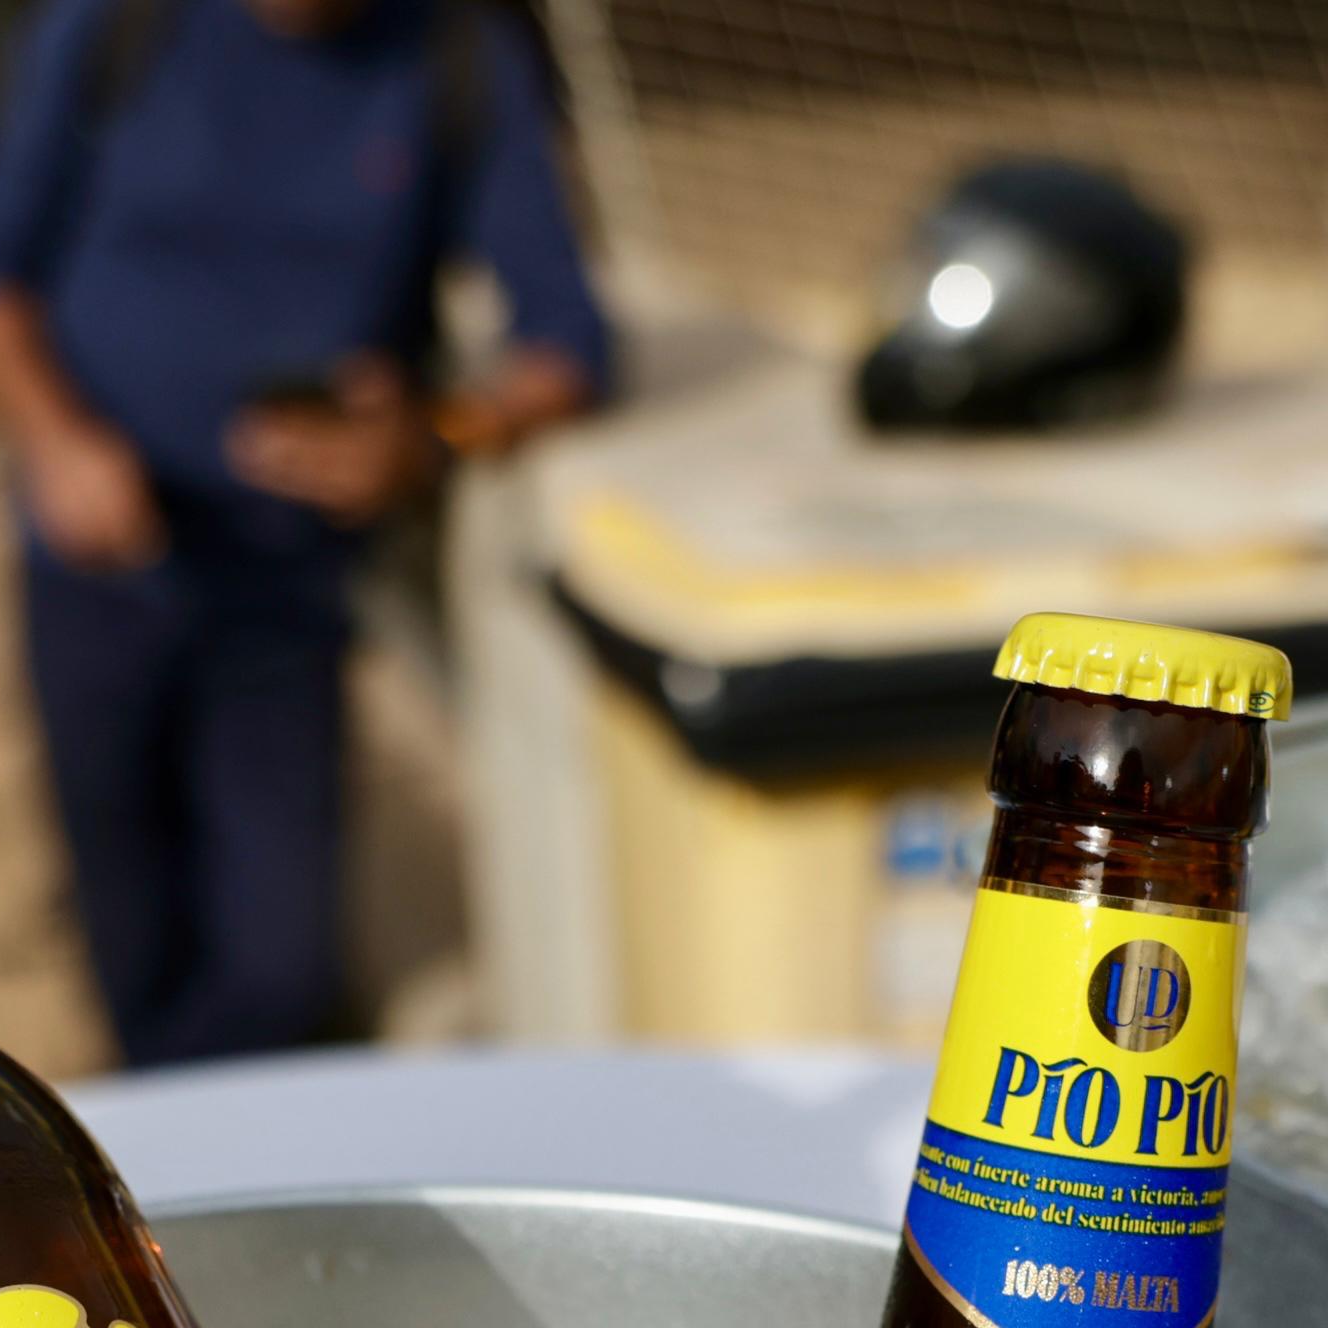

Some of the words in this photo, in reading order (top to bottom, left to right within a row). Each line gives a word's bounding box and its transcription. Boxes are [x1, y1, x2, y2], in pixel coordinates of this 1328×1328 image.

[1105, 961, 1178, 1030] UD
[982, 1046, 1121, 1149] PÍO
[1135, 1070, 1230, 1156] PÍO
[939, 1176, 1037, 1219] balanceado
[1042, 1203, 1072, 1225] del
[1078, 1208, 1185, 1235] sentimiento
[945, 1155, 971, 1173] con
[973, 1156, 1030, 1188] fuerte
[1034, 1173, 1105, 1200] aroma
[1111, 1185, 1123, 1202] a
[1130, 1184, 1198, 1207] victoria,
[1002, 1259, 1085, 1305] 100%
[1091, 1271, 1179, 1313] MALTA
